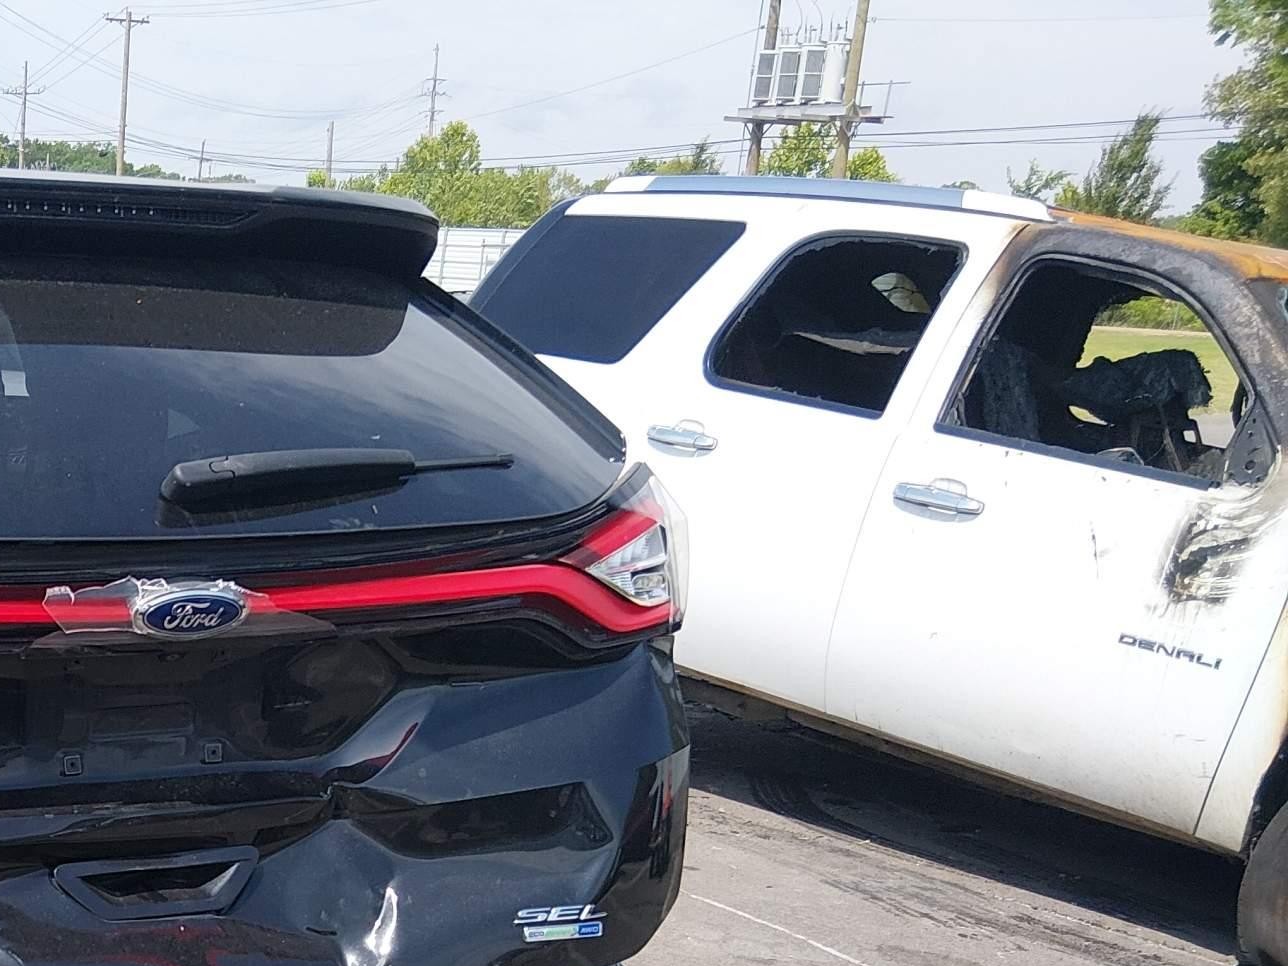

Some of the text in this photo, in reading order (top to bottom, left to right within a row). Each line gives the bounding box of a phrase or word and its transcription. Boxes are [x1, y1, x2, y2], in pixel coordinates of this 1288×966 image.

[164, 601, 225, 629] Ford
[1118, 632, 1222, 670] DENALI
[513, 904, 608, 924] SEL
